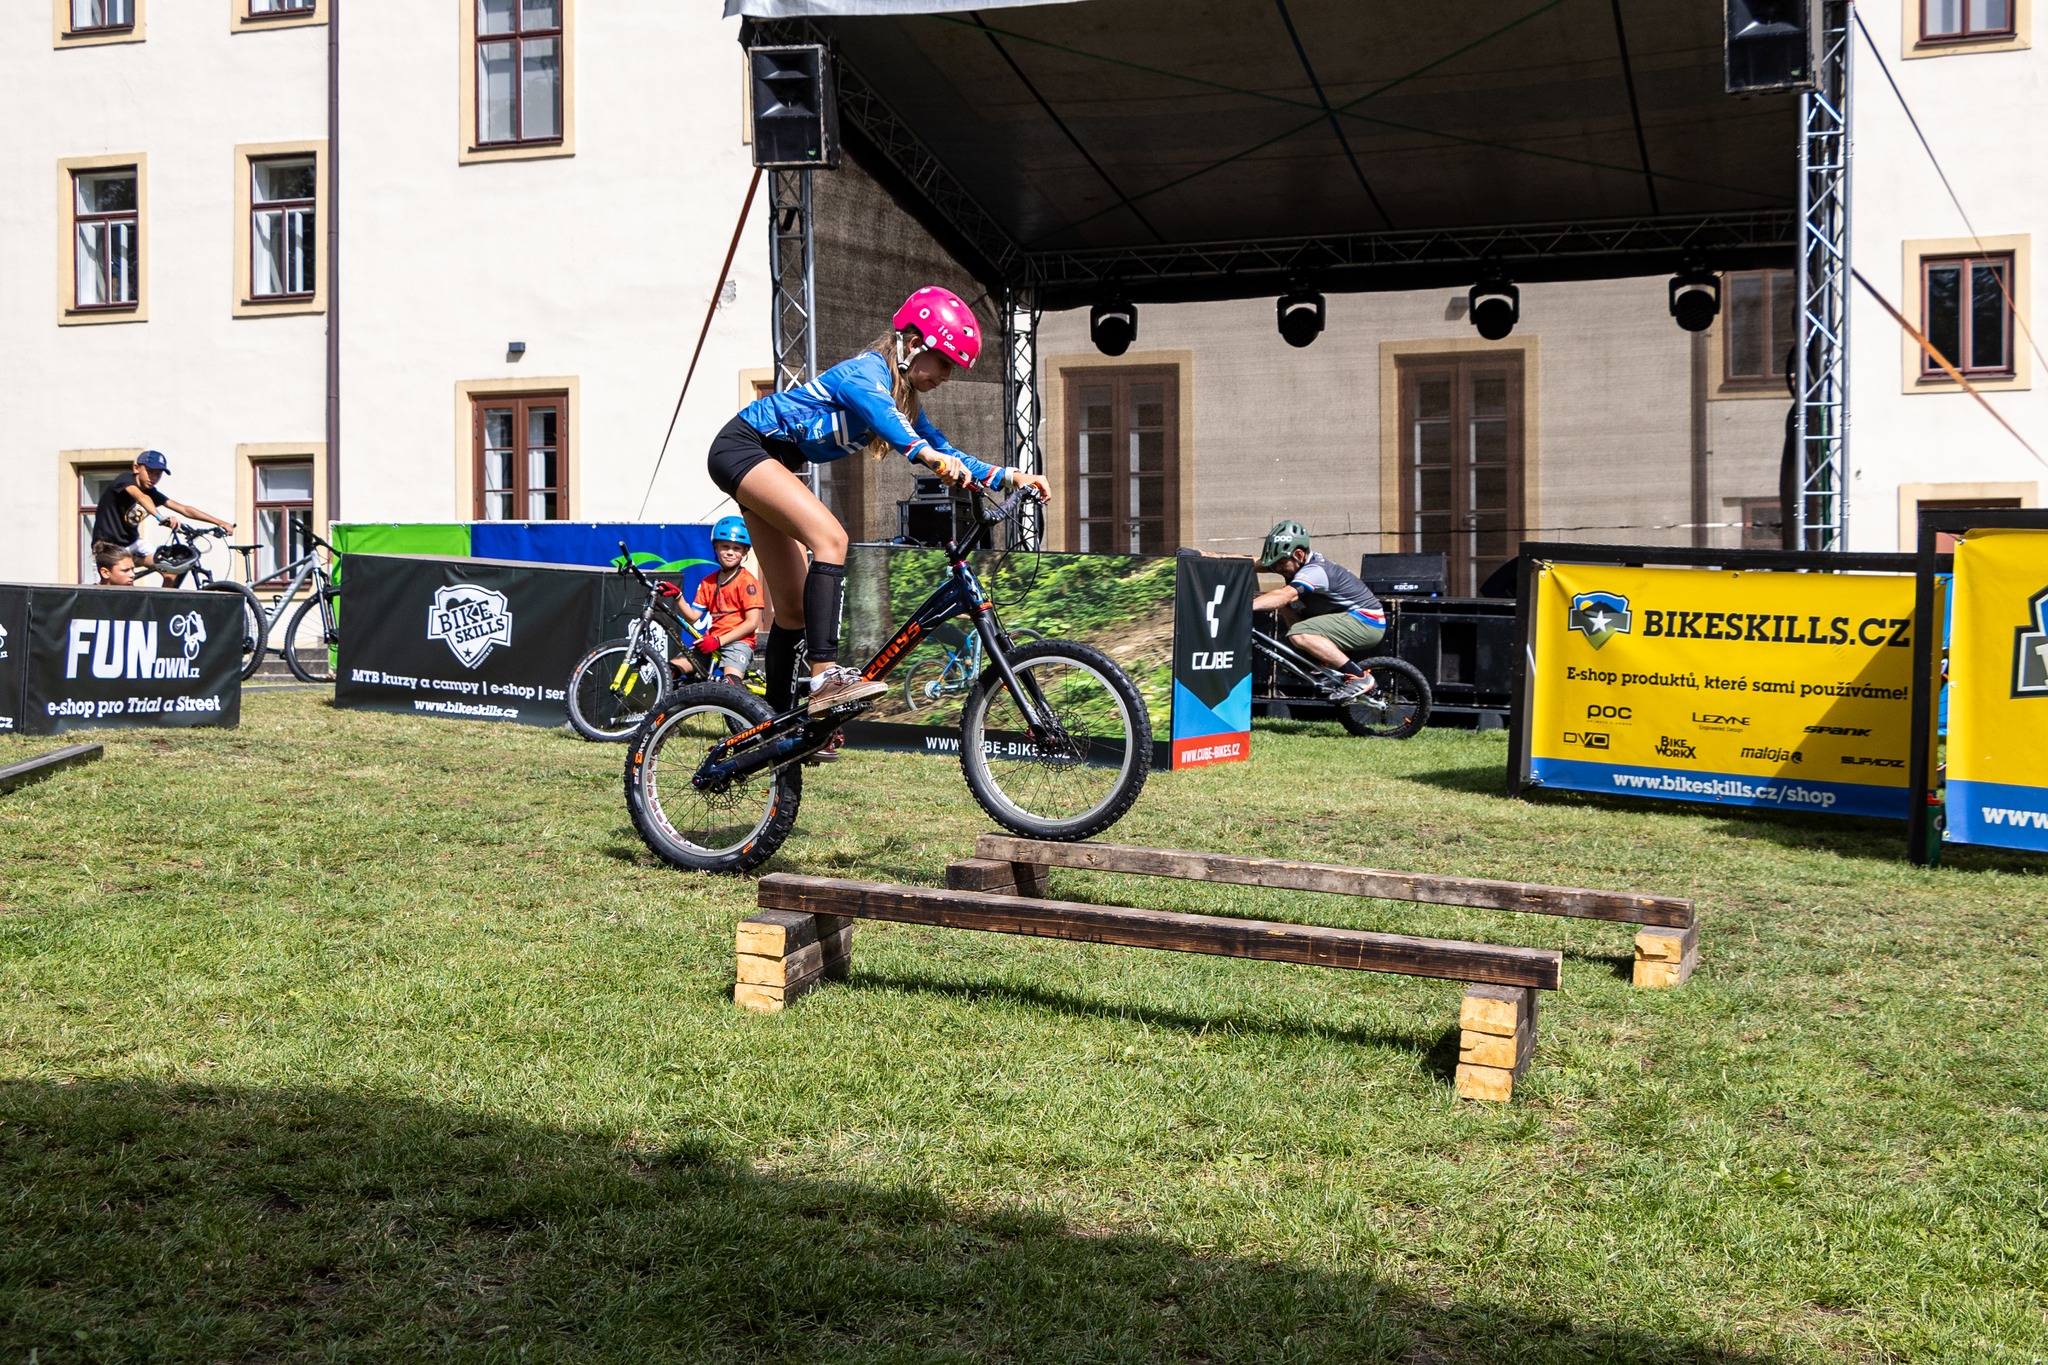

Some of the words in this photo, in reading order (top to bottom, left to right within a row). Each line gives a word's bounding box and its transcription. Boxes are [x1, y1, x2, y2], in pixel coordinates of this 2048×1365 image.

[438, 599, 494, 634] BIKE
[455, 618, 505, 644] SKILLS
[1643, 609, 1911, 648] BIKESKILLS.CZ
[1191, 650, 1235, 671] CUBE
[351, 669, 380, 683] MTB
[381, 672, 418, 689] kurzy
[420, 678, 430, 689] a
[432, 680, 479, 695] campy
[490, 683, 535, 699] e-shop
[545, 689, 566, 700] ser
[1567, 666, 1617, 686] E-shop
[1621, 672, 1700, 691] produktů,
[1704, 675, 1748, 690] které
[1752, 680, 1796, 694] sami
[1800, 681, 1909, 700] používáme!
[47, 698, 95, 718] e-shop
[97, 699, 124, 717] pro
[127, 697, 162, 713] Trial
[163, 700, 175, 712] a
[176, 695, 221, 712] Street
[414, 700, 519, 718] www.bikeskills.cz
[1587, 704, 1633, 719] POC
[1692, 712, 1751, 726] LEZYNE
[1563, 732, 1609, 747] DVO
[1661, 736, 1687, 748] BIKE
[1181, 743, 1241, 764] WWW.CUBE-BIKES.CZ
[1740, 747, 1790, 763] maloja
[1612, 773, 1836, 808] www.bikeskills.cz/shop
